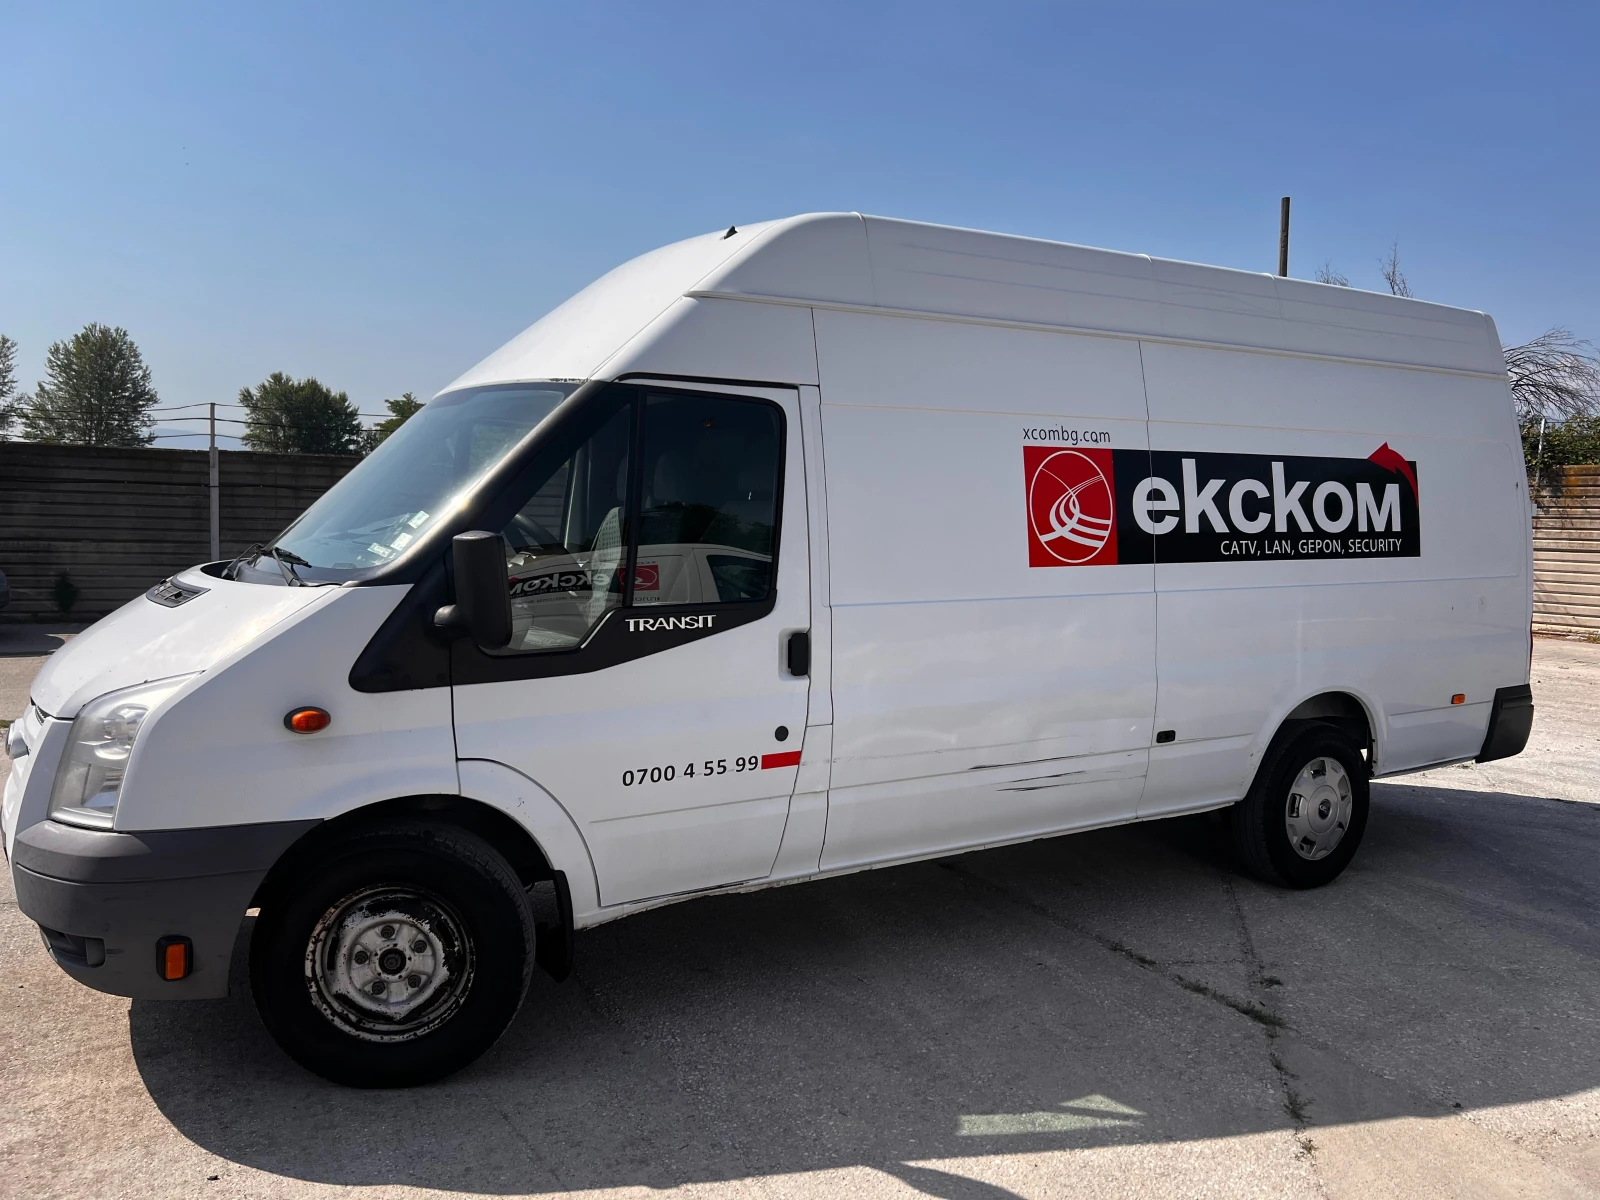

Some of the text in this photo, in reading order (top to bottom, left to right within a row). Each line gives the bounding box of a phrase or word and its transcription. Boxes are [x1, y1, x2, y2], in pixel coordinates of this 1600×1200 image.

[1022, 426, 1111, 446] xcombg.com
[1220, 538, 1402, 556] CATV, LAN, GEPON, SECURITY
[625, 615, 717, 632] TRANSIT
[622, 755, 759, 786] 0700 4 55 99
